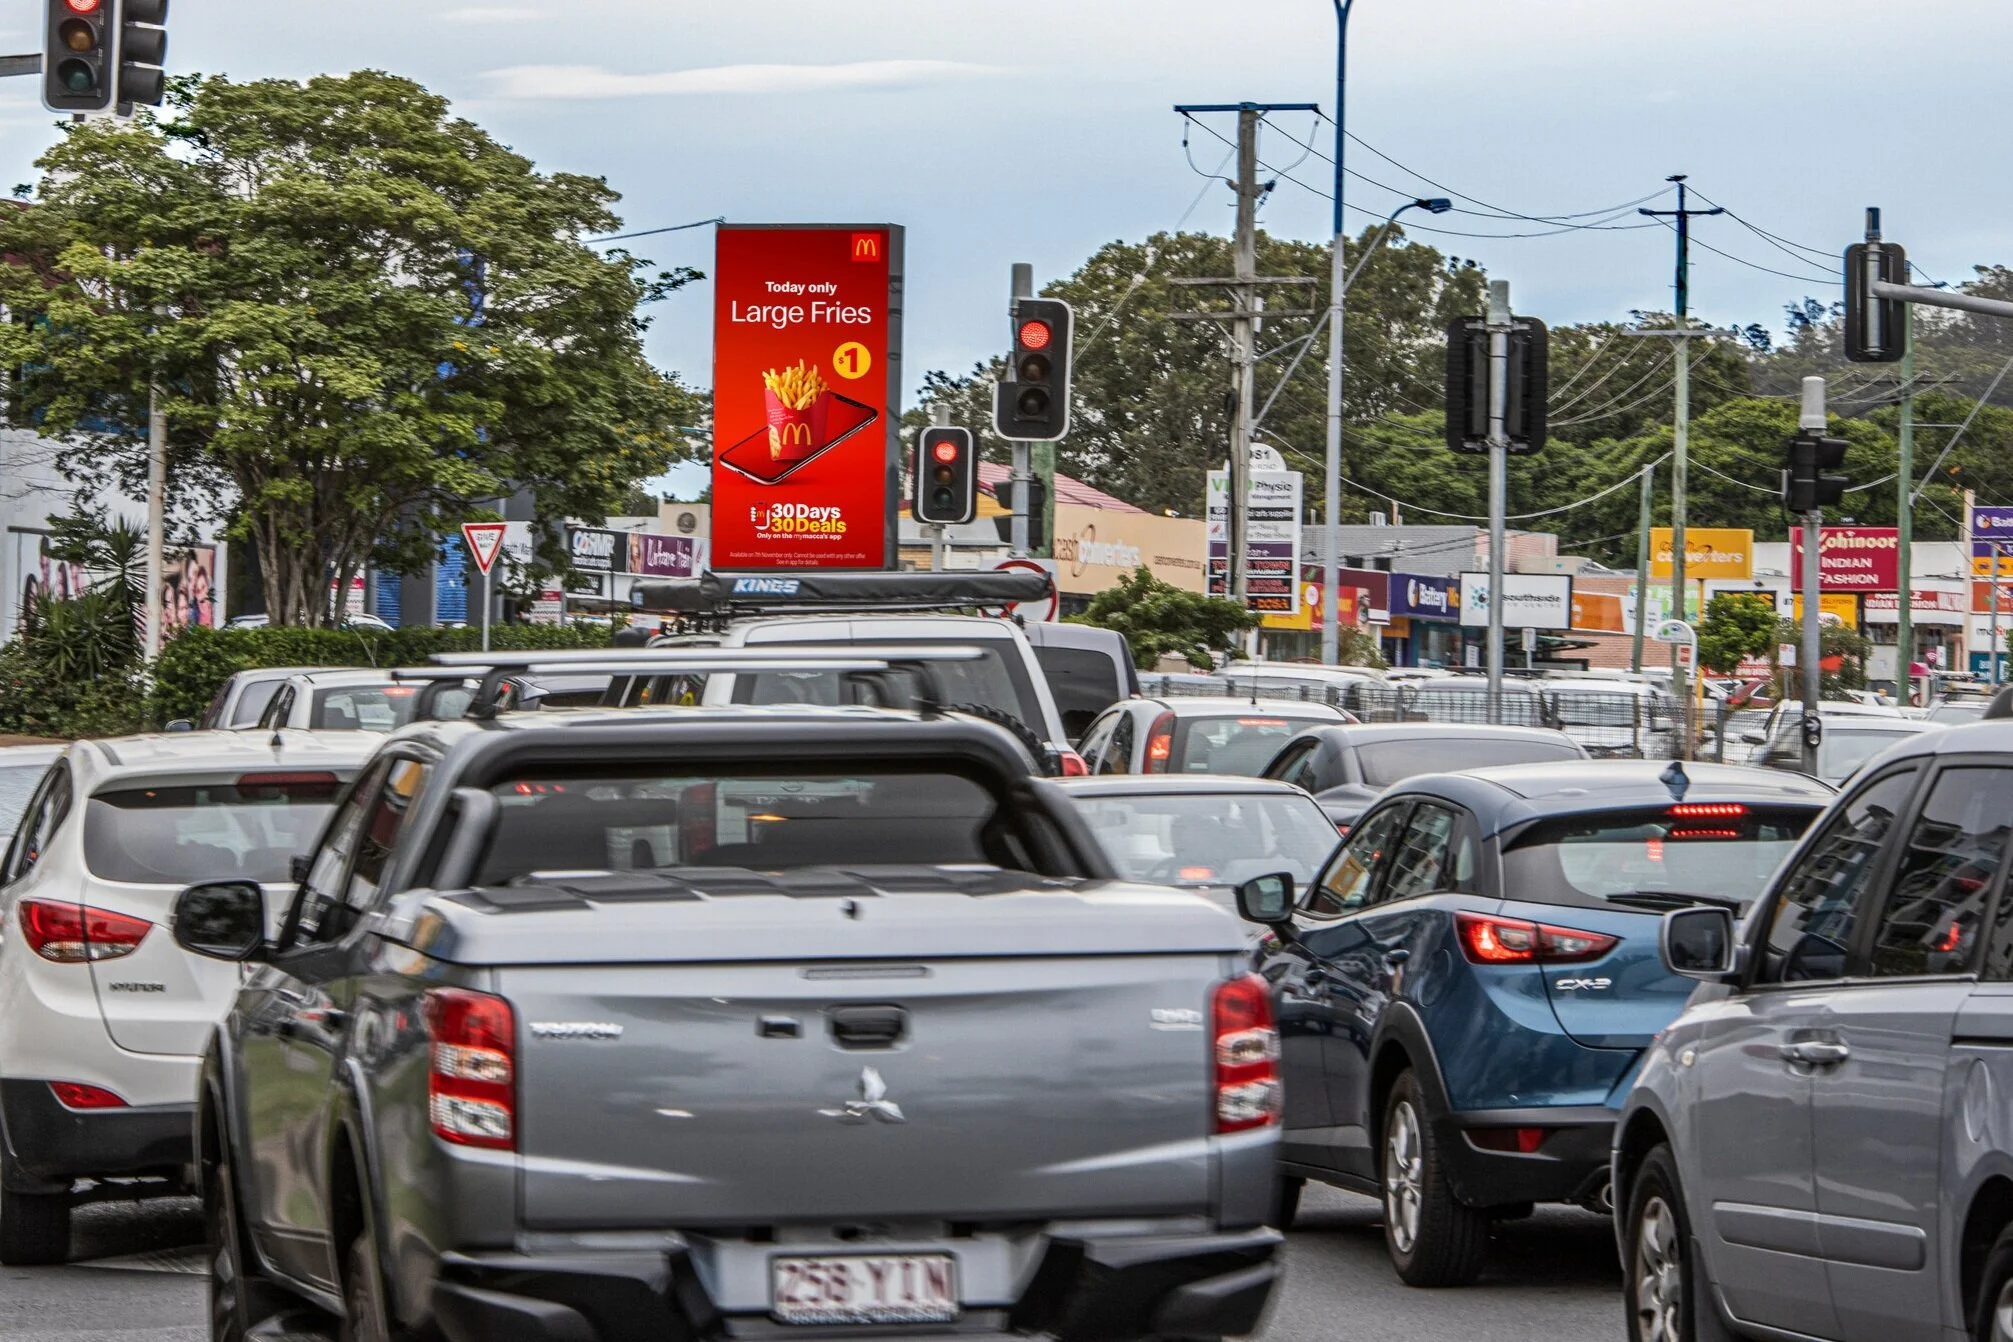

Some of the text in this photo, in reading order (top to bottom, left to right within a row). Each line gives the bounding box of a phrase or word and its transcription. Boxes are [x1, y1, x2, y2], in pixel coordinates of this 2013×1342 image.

[765, 281, 838, 297] Today only
[731, 300, 872, 330] Large Fries
[838, 347, 858, 373] $1
[771, 503, 841, 522] 30 Days
[771, 518, 847, 533] 30 Deals
[477, 532, 496, 541] GIVE
[1821, 557, 1873, 568] INDIAN
[732, 577, 800, 594] KINGS
[1419, 582, 1448, 613] Battery
